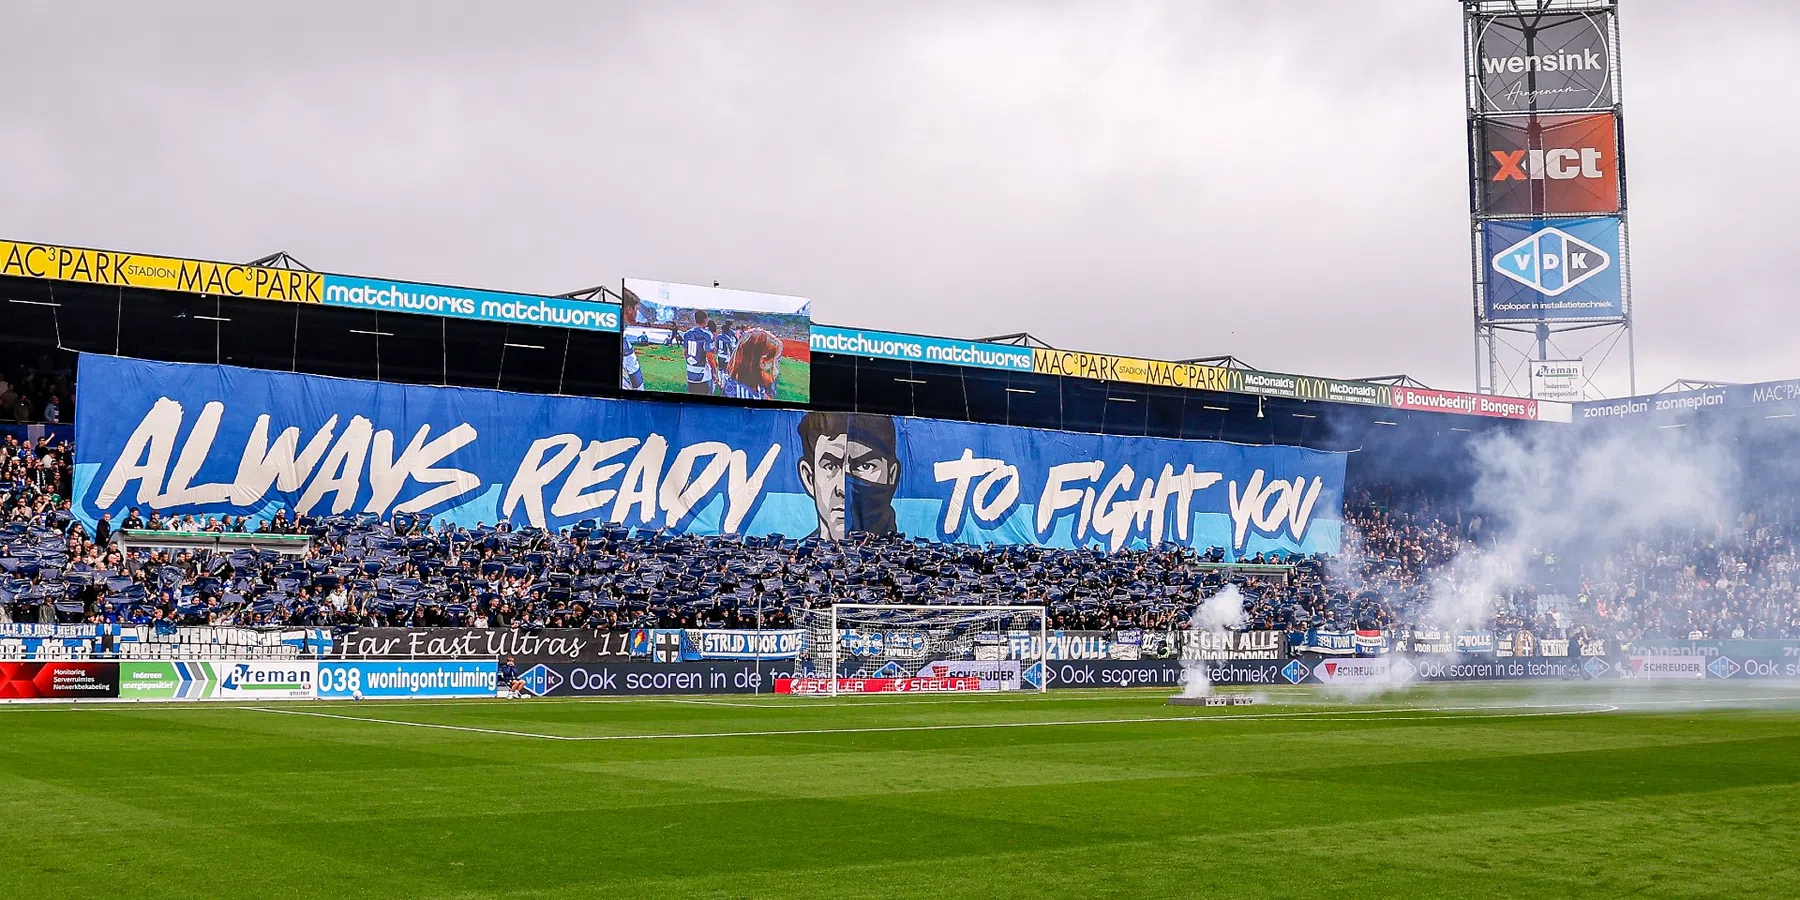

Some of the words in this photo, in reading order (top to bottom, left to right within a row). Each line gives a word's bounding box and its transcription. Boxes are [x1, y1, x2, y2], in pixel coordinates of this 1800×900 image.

[1483, 48, 1601, 74] wensink
[1514, 253, 1588, 271] VDK
[128, 264, 176, 279] STADION
[327, 284, 475, 314] matchworks
[481, 300, 617, 329] matchworks
[1493, 302, 1530, 311] Koploper
[810, 333, 922, 358] matchworks
[927, 345, 1031, 369] matchworks
[1119, 366, 1147, 376] STADION
[1540, 366, 1578, 374] Breman
[1245, 374, 1294, 389] McDonald's
[1330, 383, 1376, 397] McDonald's
[1407, 391, 1477, 412] Bouwbedrijf
[1481, 397, 1525, 416] Bongers
[1584, 401, 1648, 418] zonneplan
[1655, 394, 1723, 412] zonneplan
[96, 397, 481, 519] ALWAYS
[503, 433, 782, 534] READY
[935, 448, 1020, 534] TO
[1229, 469, 1322, 550] YOU
[216, 627, 259, 646] VOOR
[262, 631, 282, 647] JE
[340, 630, 400, 658] Far
[407, 631, 481, 658] East
[485, 629, 587, 658] Ultras
[704, 634, 743, 652] STRIJD
[747, 635, 778, 652] VOOR
[1183, 630, 1234, 650] TEGEN
[1239, 630, 1279, 650] ALLE
[1457, 635, 1491, 647] ZWOLLE
[1046, 635, 1107, 660] ZWOLLE
[53, 669, 85, 677] Monitoring
[232, 666, 310, 682] Breman
[1061, 664, 1095, 683] Ook
[1102, 667, 1158, 683] scoren
[1163, 664, 1175, 683] in
[1207, 664, 1277, 683] techniek?
[1420, 661, 1445, 677] Ook
[1451, 664, 1492, 677] scoren
[1496, 661, 1505, 676] in
[1509, 661, 1523, 676] de
[1643, 663, 1700, 672] SCHREUDER
[1745, 660, 1780, 676] Ook
[123, 681, 174, 691] energiepositief
[318, 667, 360, 692] 038
[367, 667, 497, 692] woningontruiming
[526, 676, 555, 685] VDK
[570, 667, 617, 689] Ook
[627, 671, 702, 689] scoren
[710, 667, 727, 688] in
[734, 667, 762, 688] de
[910, 680, 965, 691] STELLA
